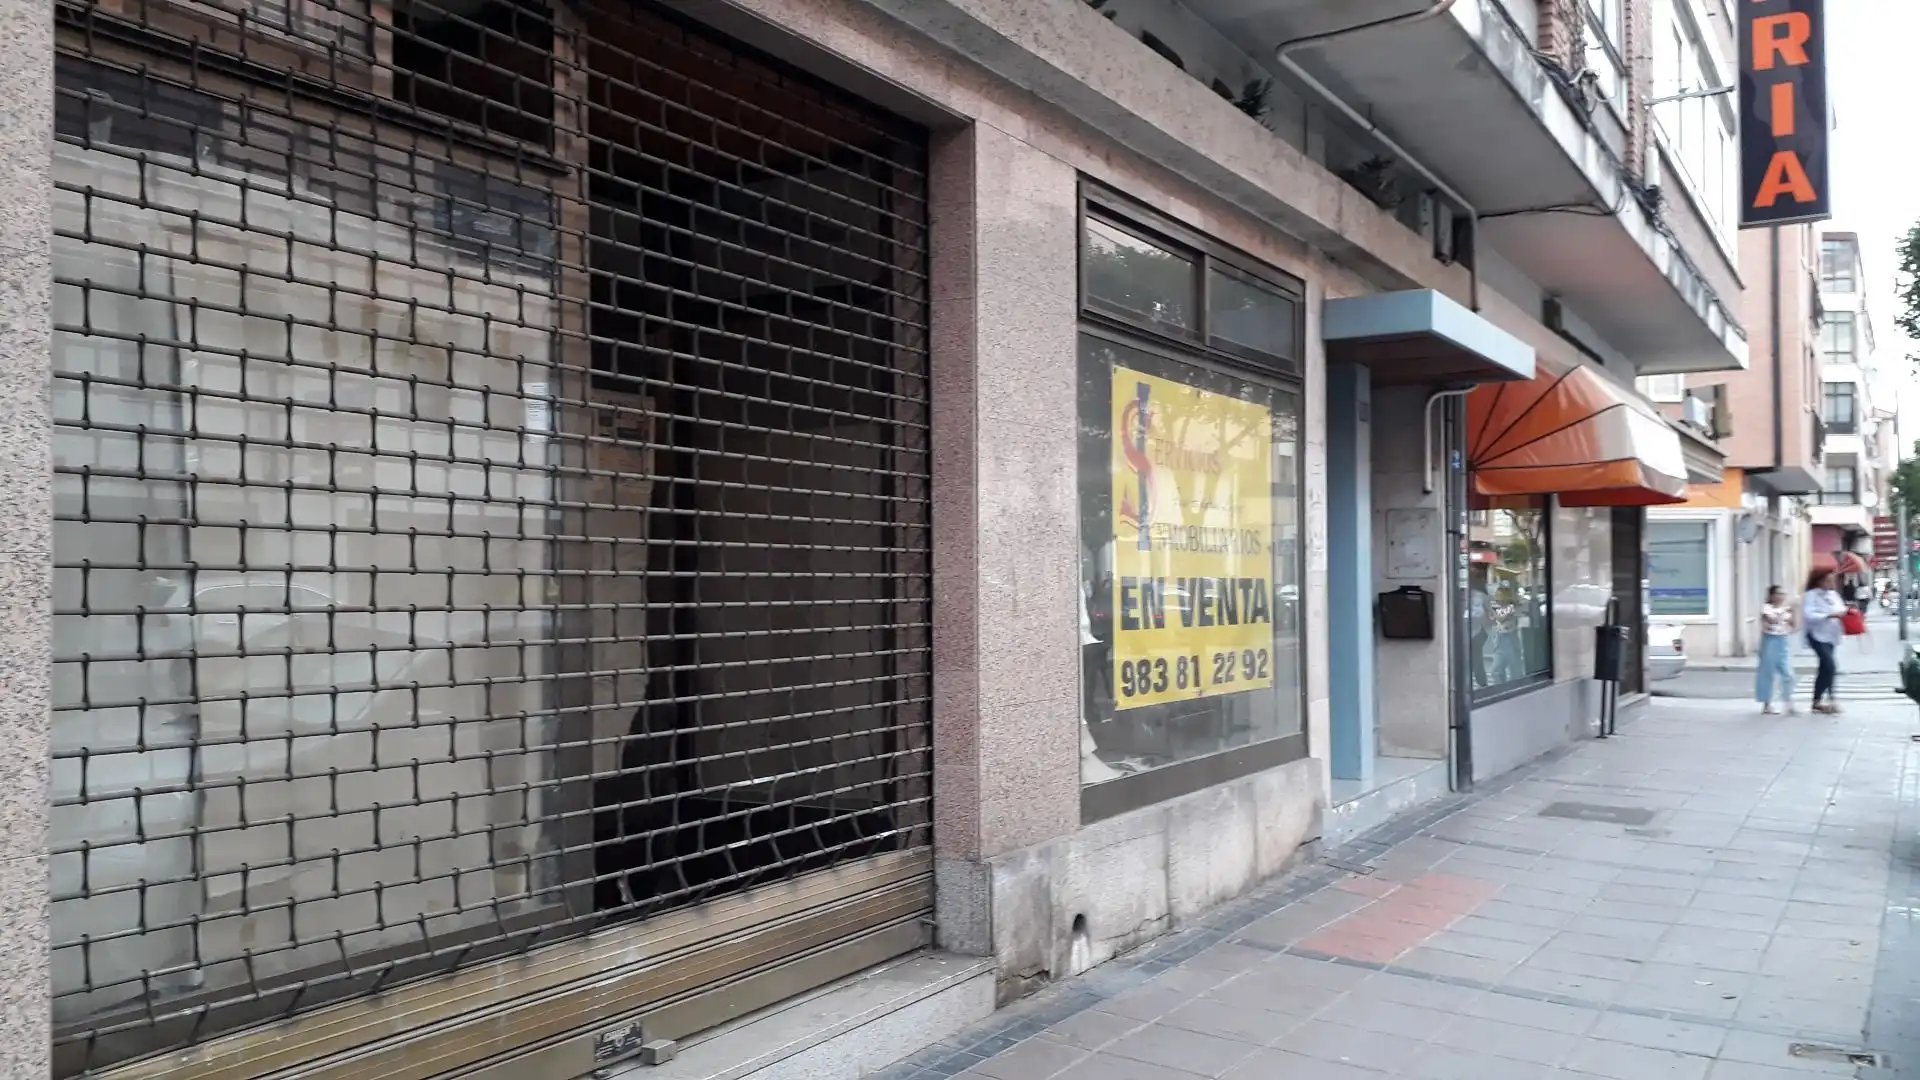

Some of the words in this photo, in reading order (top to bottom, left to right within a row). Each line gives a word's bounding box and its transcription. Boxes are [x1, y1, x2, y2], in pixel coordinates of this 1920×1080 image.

[1751, 0, 1817, 208] RIA
[1120, 576, 1166, 630] EN
[1177, 577, 1271, 628] VENTA
[1121, 657, 1169, 698] 983
[1175, 654, 1201, 690] 81
[1212, 650, 1236, 684] 22
[1242, 647, 1268, 680] 92
